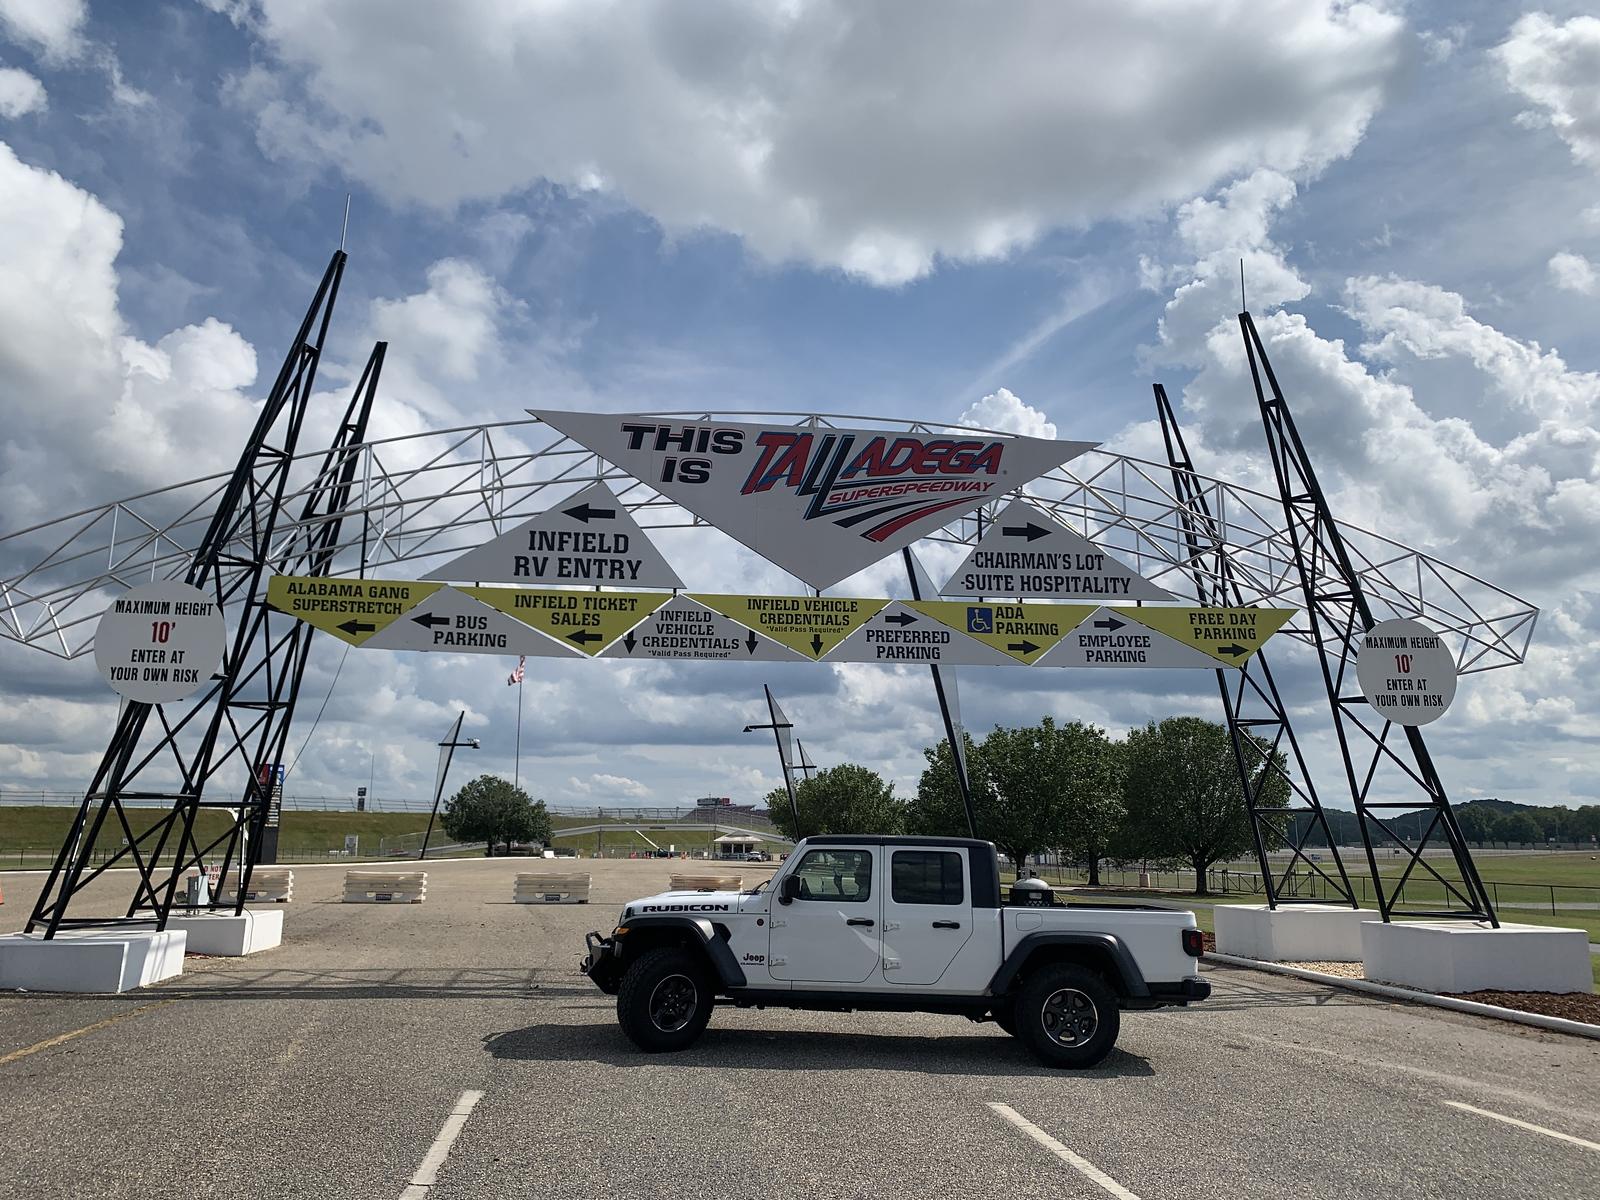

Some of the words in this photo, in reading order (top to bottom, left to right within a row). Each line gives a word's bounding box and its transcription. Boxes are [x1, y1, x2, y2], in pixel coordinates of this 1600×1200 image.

[621, 422, 745, 455] THIS
[661, 456, 712, 484] IS
[740, 430, 1004, 520] TALLADEGA
[827, 481, 994, 505] SUPERSPEEDWAY
[529, 530, 630, 554] INFIELD
[514, 556, 549, 577] RV
[558, 557, 642, 580] ENTRY
[1076, 554, 1104, 571] LOT
[287, 583, 363, 598] ALABAMA
[368, 586, 410, 600] GANG
[1020, 575, 1132, 594] HOSPITALITY
[115, 600, 170, 615] MAXIMUM
[174, 602, 213, 616] HEIGHT
[293, 598, 402, 615] SUPERSTRETCH
[514, 594, 578, 610] INFIELD
[583, 597, 638, 612] TICKET
[747, 599, 800, 612] INFIELD
[804, 600, 858, 613] VEHICLE
[551, 612, 601, 627] SALES
[660, 610, 711, 623] INFIELD
[760, 612, 850, 627] CREDENTIALS
[995, 606, 1025, 620] ADA
[1189, 613, 1222, 627] FREE
[1229, 613, 1257, 627] DAY
[455, 616, 488, 630] BUS
[656, 623, 714, 637] VEHICLE
[790, 626, 807, 634] Pass
[996, 622, 1059, 637] PARKING
[433, 630, 507, 648] PARKING
[866, 629, 950, 645] PREFERRED
[1194, 627, 1257, 641] PARKING
[642, 635, 739, 650] CREDENTIALS
[1079, 635, 1151, 649] EMPLOYEE
[1366, 637, 1408, 649] MAXIMUM
[1411, 637, 1440, 649] HEIGHT
[131, 649, 165, 664] ENTER
[170, 650, 185, 664] AT
[876, 645, 941, 661] PARKING
[1086, 650, 1146, 664] PARKING
[110, 666, 138, 681] YOUR
[143, 668, 168, 682] OWN
[172, 668, 199, 683] RISK
[1386, 679, 1414, 691] ENTER
[1417, 679, 1427, 691] AT
[1375, 695, 1398, 707] YOUR
[1401, 695, 1421, 707] OWN
[1423, 695, 1444, 707] RISK
[642, 904, 729, 913] RUBICON
[743, 952, 765, 962] Jeep
